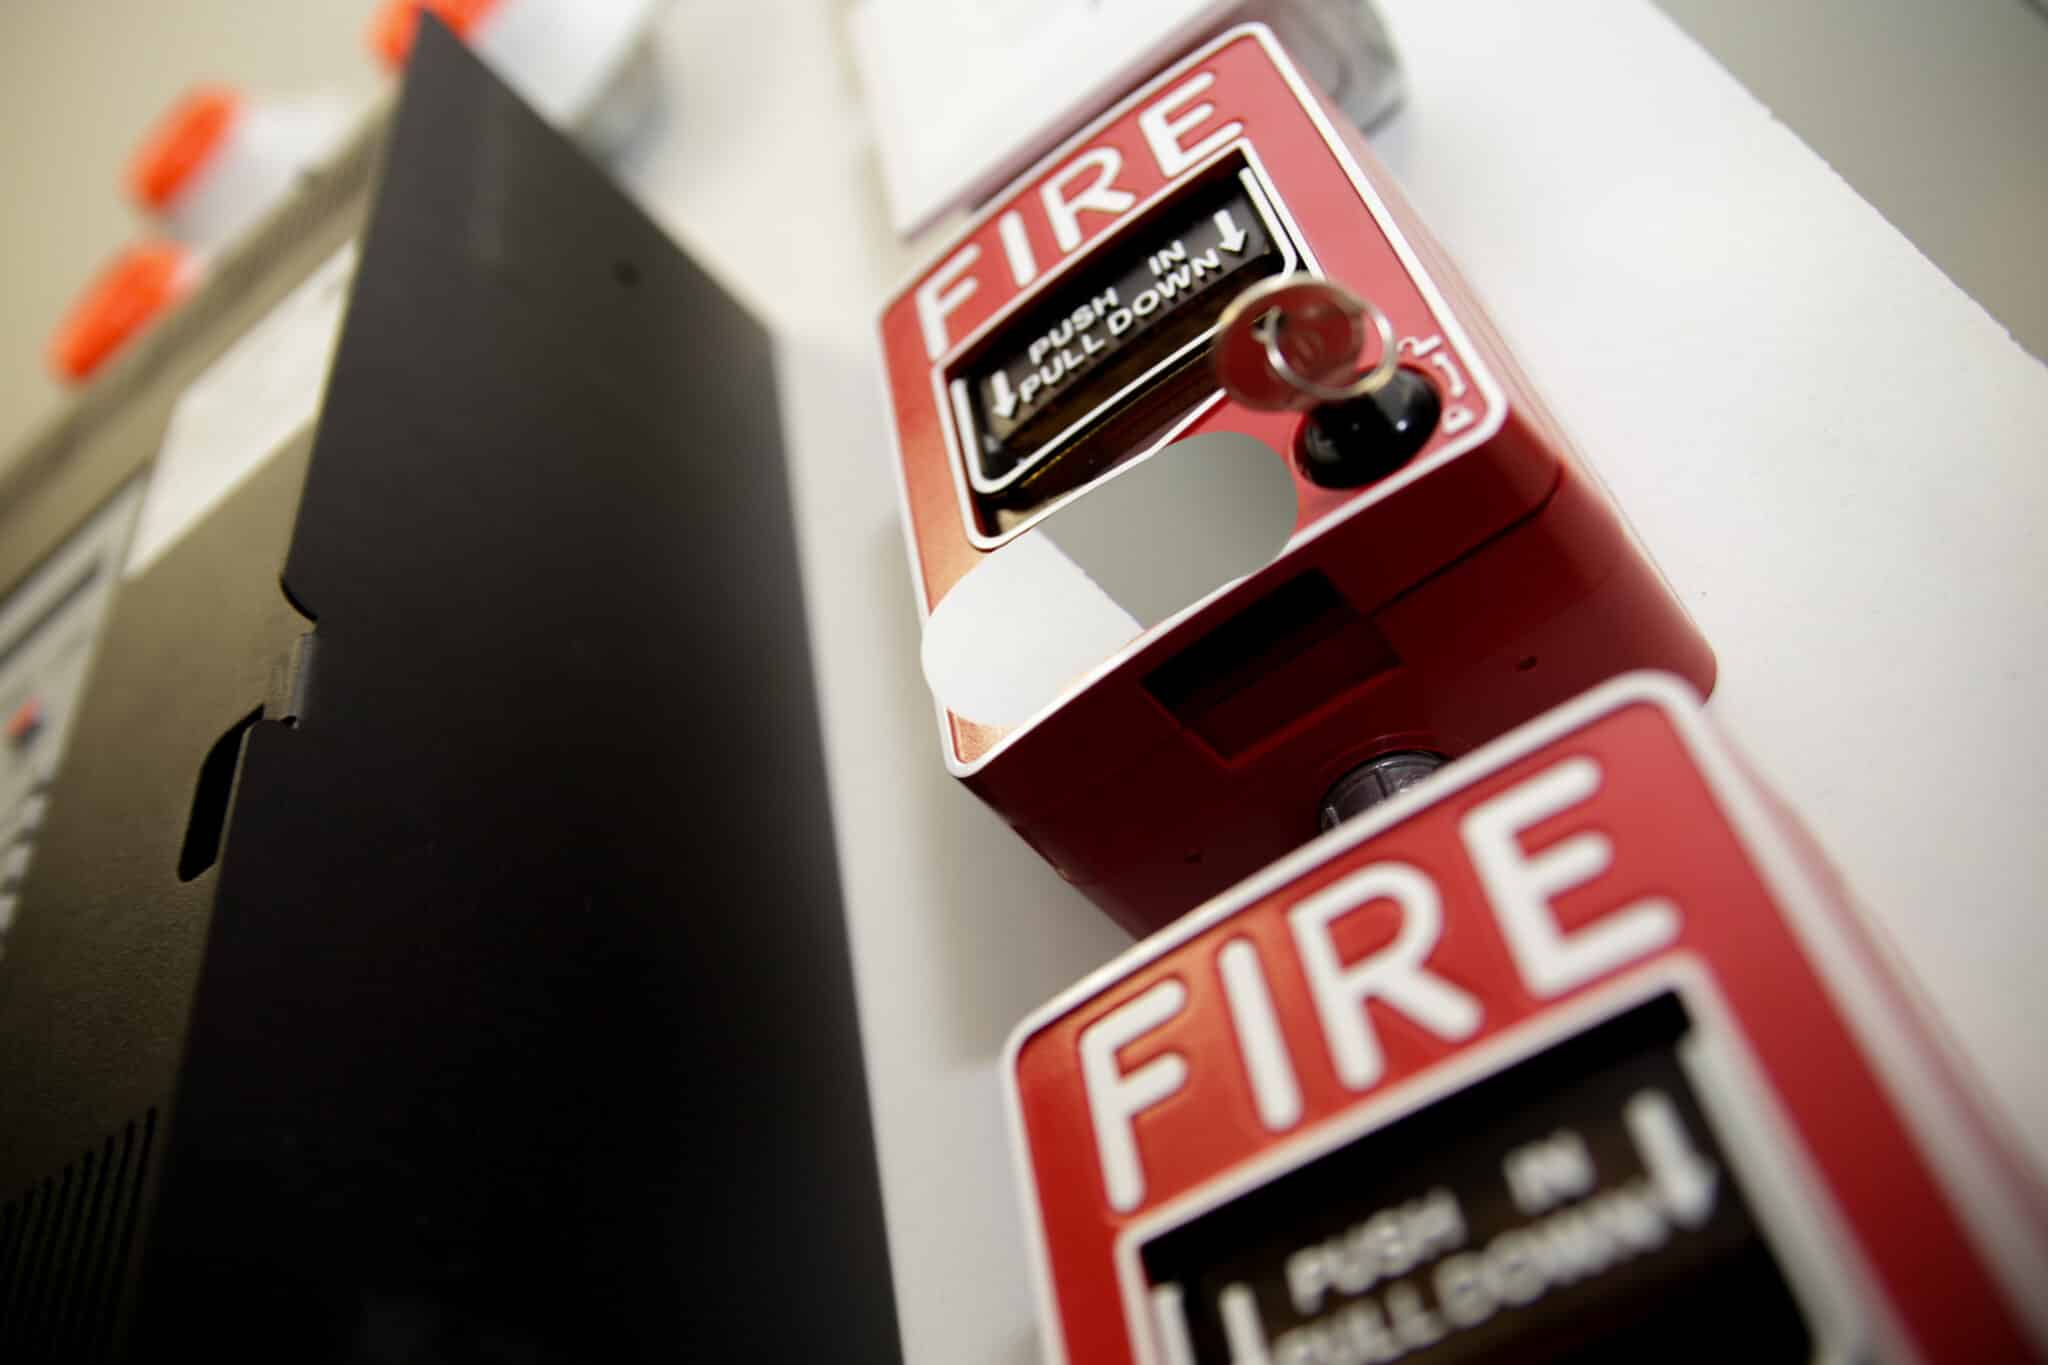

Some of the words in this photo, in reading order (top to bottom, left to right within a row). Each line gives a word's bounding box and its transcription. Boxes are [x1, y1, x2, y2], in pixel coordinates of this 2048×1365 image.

[915, 71, 1244, 360] FIRE
[1028, 287, 1119, 364] PUSH
[1149, 240, 1187, 276] IN
[1019, 333, 1104, 403] PULL
[1106, 247, 1220, 336] DOWN
[1078, 756, 1683, 1213] FIRE
[1286, 1187, 1467, 1314] PUSH
[1504, 1129, 1593, 1214] IN
